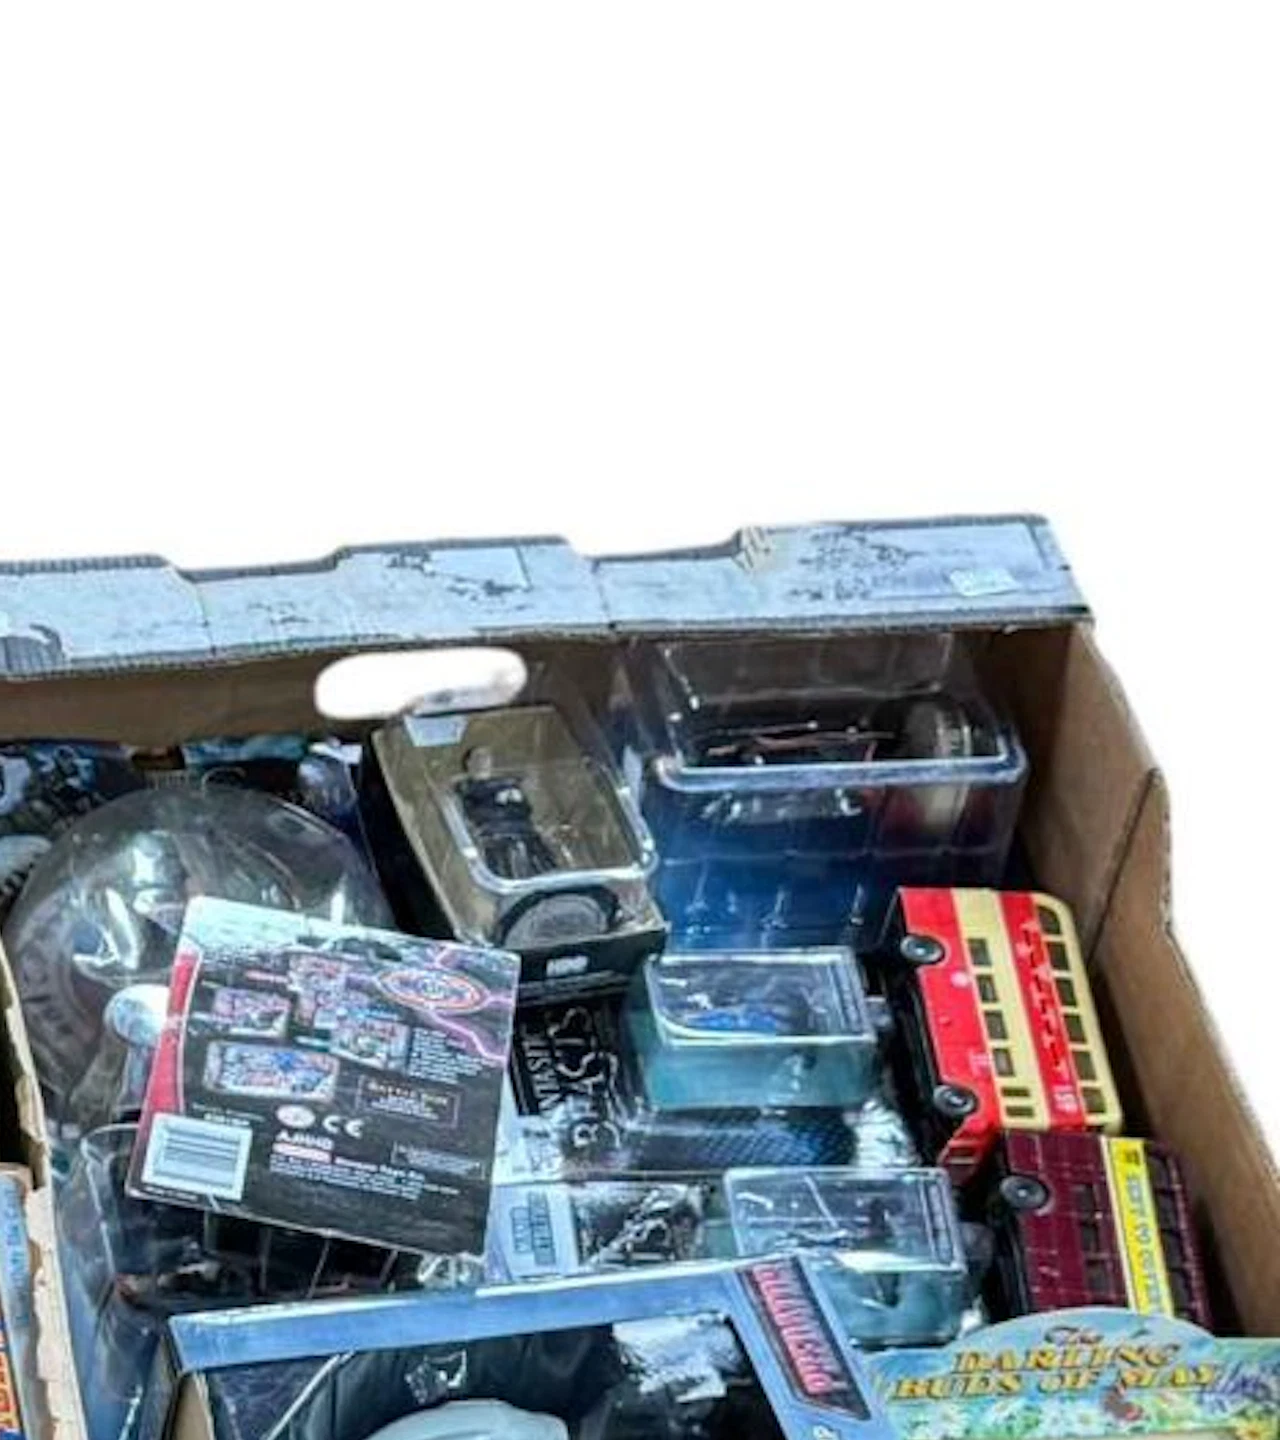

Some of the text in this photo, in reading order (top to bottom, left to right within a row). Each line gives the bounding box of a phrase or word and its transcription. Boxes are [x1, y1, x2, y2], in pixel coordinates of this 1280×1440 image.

[951, 1341, 1179, 1374] DARLING
[890, 1373, 1021, 1400] BUDS
[1116, 1364, 1217, 1390] MAY
